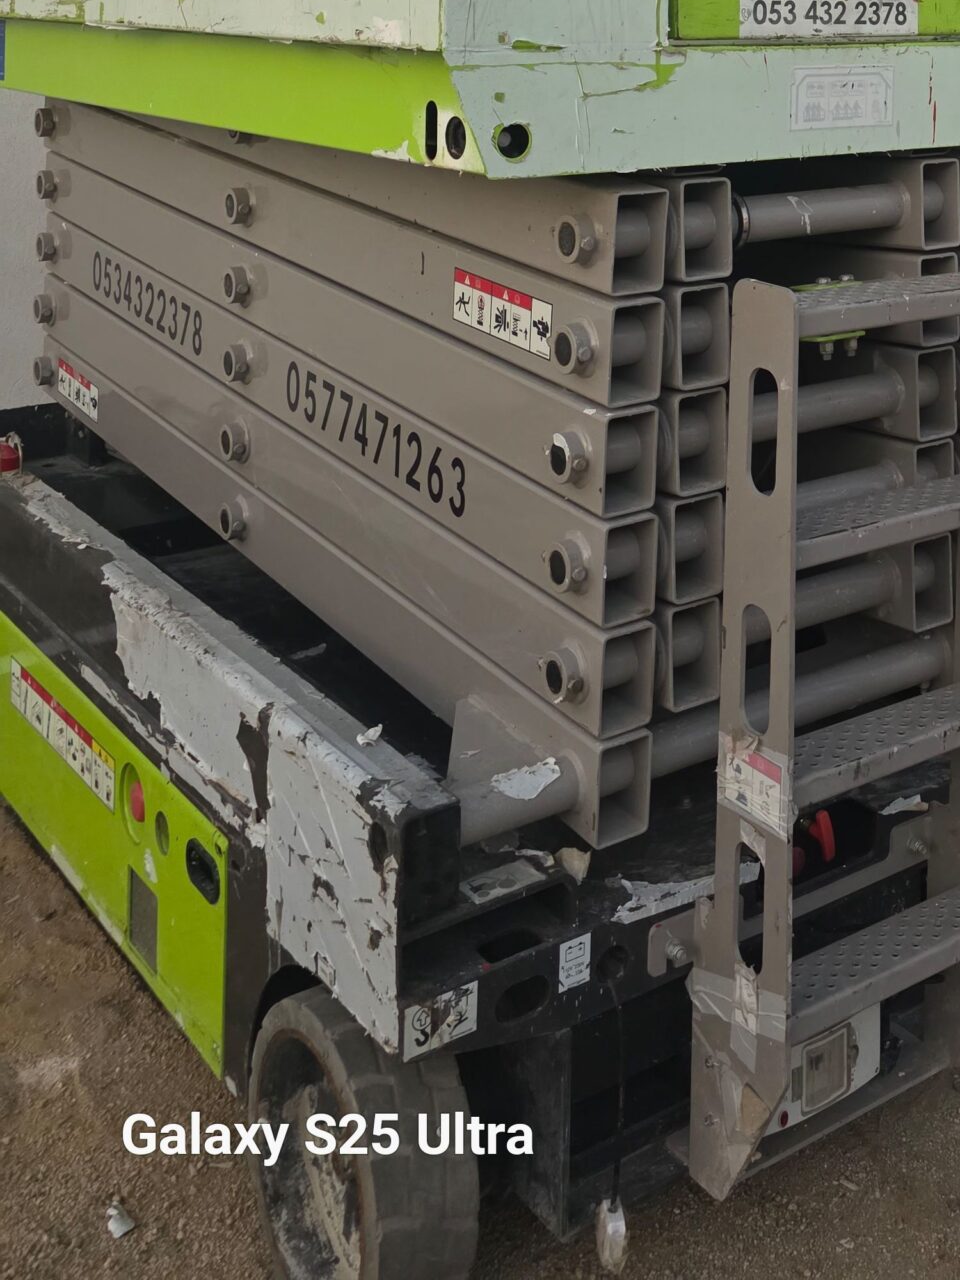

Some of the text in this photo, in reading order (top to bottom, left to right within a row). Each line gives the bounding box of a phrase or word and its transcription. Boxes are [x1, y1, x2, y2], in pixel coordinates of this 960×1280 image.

[752, 0, 907, 26] 053 432 2378
[93, 251, 202, 356] 0534322378
[286, 361, 466, 518] 0577471263
